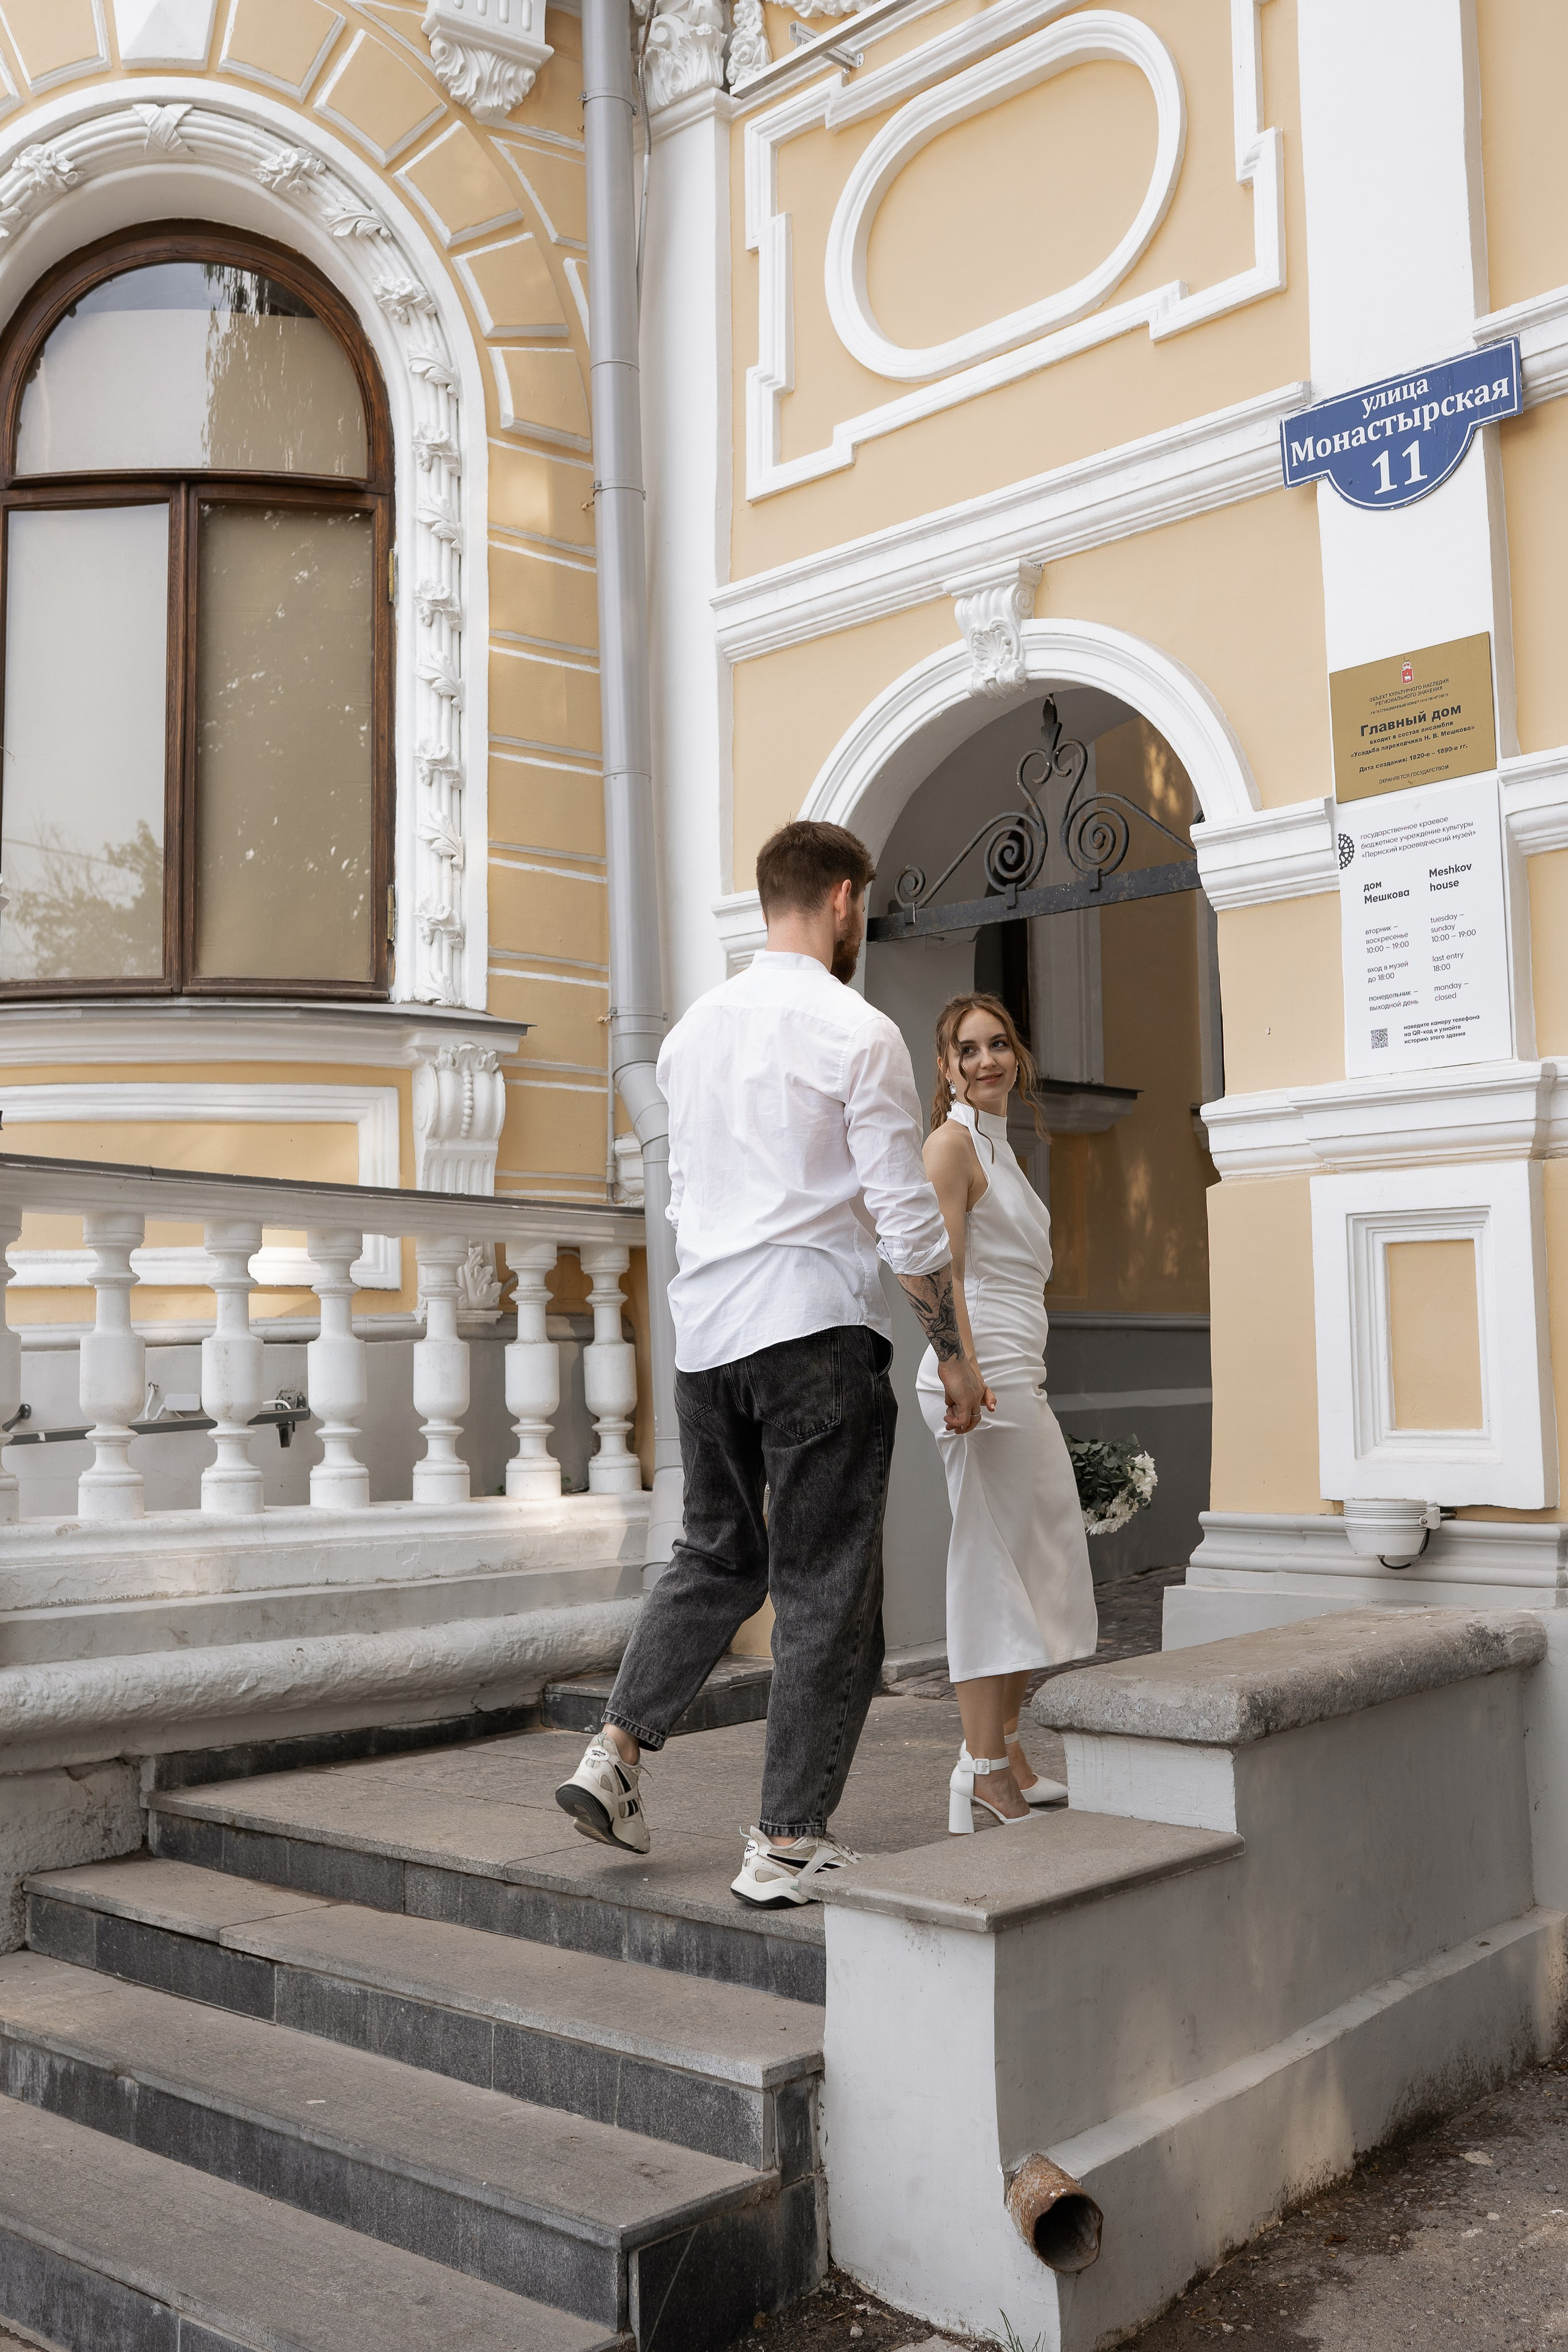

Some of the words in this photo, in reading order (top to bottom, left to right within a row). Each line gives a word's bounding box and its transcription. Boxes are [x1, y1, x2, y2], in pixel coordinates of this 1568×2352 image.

[1362, 379, 1429, 418] улица
[1291, 377, 1509, 467] Монастырская
[1371, 440, 1427, 494] 11
[1389, 685, 1422, 697] КУЛЬТУРНОГО
[1423, 679, 1449, 688] НАСЛЕДИЯ
[1375, 693, 1416, 706] РЕГИОНАЛЬНОГО
[1417, 686, 1442, 696] ЗНАЧЕНИЯ
[1360, 710, 1427, 736] Главный
[1431, 705, 1461, 722] дом
[1370, 736, 1390, 745] входит
[1421, 721, 1453, 733] ансамбля
[1351, 747, 1379, 758] «Усадьба
[1381, 737, 1422, 751] пароходчика
[1441, 725, 1475, 737] Мешкова»
[1376, 757, 1408, 767] создания:
[1379, 773, 1409, 784] ОХРАНЯЕТСЯ
[1411, 764, 1449, 777] ГОСУДАРСТВОМ
[1360, 823, 1417, 840] государственное
[1419, 816, 1448, 829] краевое
[1361, 836, 1398, 850] бюджетное
[1400, 827, 1441, 842] учреждение
[1442, 821, 1474, 833] культуры
[1362, 846, 1398, 858] «Пермский
[1399, 835, 1451, 851] краеведческий
[1452, 831, 1476, 842] музей»
[1429, 864, 1472, 878] Meshkov
[1363, 881, 1382, 892] дом
[1430, 879, 1459, 891] house
[1364, 889, 1410, 904] Мешкова
[1430, 913, 1457, 923] tuesday
[1365, 926, 1392, 935] вторник
[1431, 924, 1455, 933] sunday
[1366, 932, 1409, 944] воскресенье
[1431, 933, 1449, 942] 10:00
[1458, 929, 1476, 938] 19:00
[1392, 941, 1409, 949] 19:00
[1446, 952, 1464, 960] entry
[1389, 961, 1409, 970] музей
[1434, 982, 1462, 991] monday
[1369, 990, 1411, 1001] понедельник
[1434, 992, 1457, 1001] closed
[1370, 1001, 1401, 1011] выходной
[1403, 999, 1419, 1008] день
[1439, 1024, 1461, 1033] узнайте
